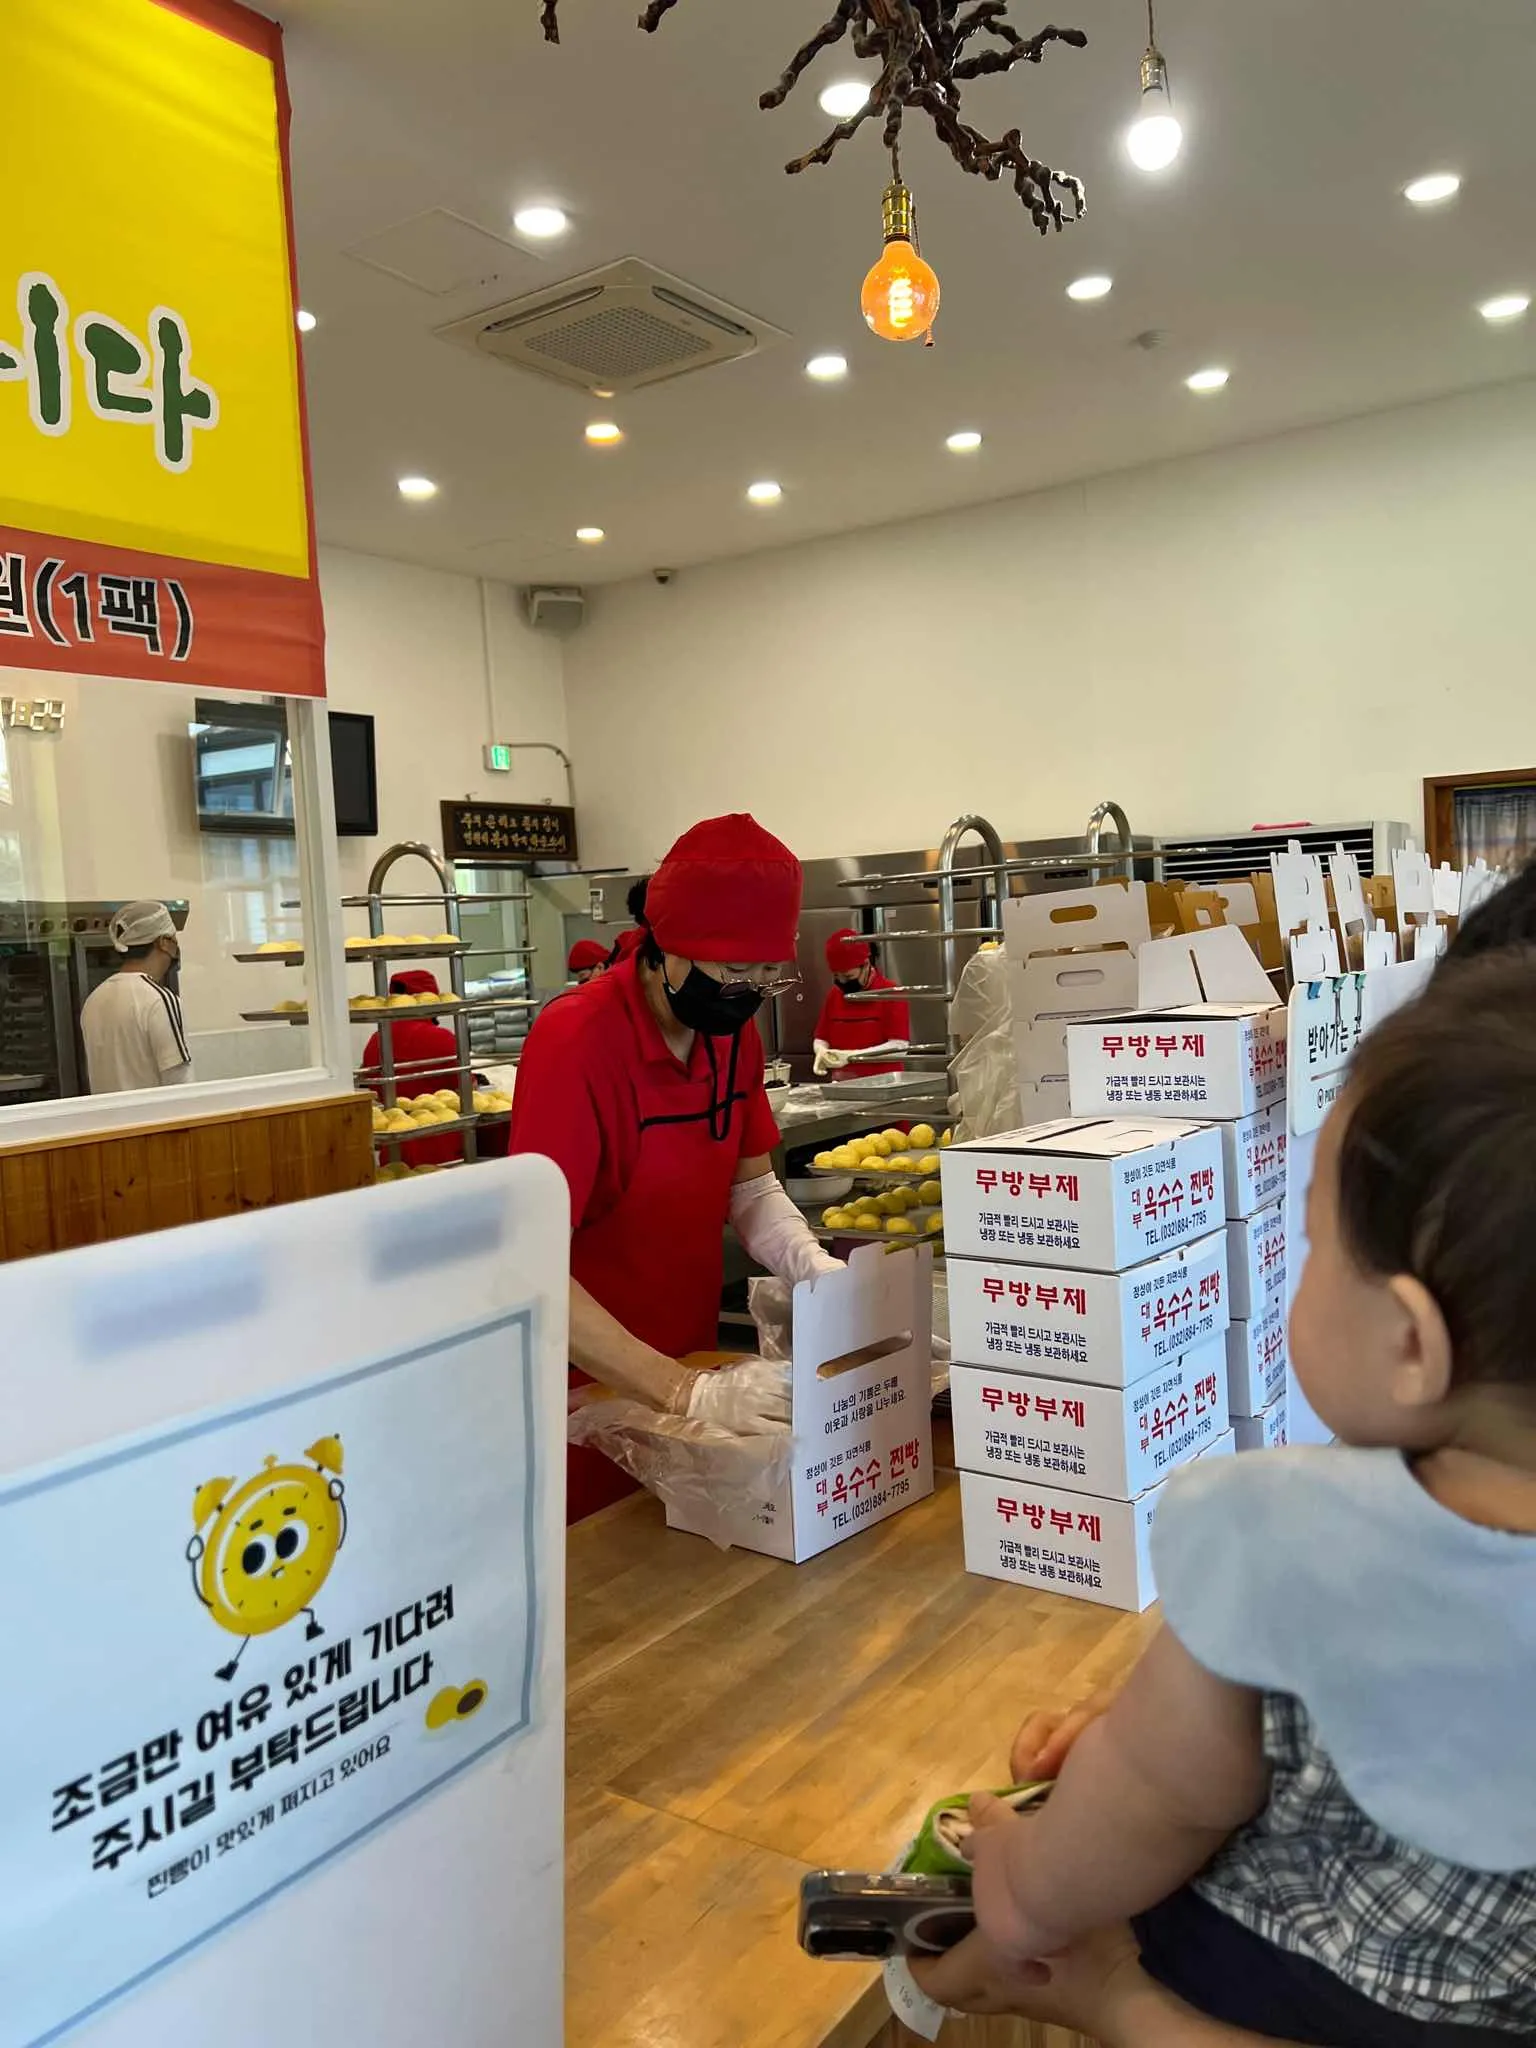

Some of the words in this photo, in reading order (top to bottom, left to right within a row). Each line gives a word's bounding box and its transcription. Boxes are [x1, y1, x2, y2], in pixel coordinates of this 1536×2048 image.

[1102, 1034, 1204, 1058] 무방부제
[1308, 1020, 1348, 1063] 받아가는
[1106, 1075, 1128, 1087] 가급적
[1131, 1075, 1146, 1087] 빨리
[1148, 1075, 1172, 1087] 드시고
[1174, 1075, 1206, 1087] 보관시는
[1107, 1090, 1123, 1101] 냉장
[1126, 1090, 1142, 1101] 또는
[1145, 1090, 1161, 1101] 냉동
[1164, 1090, 1207, 1101] 보관하세요
[976, 1169, 1079, 1202] 무방부제
[1124, 1168, 1141, 1184] 정성이
[1142, 1164, 1153, 1177] 깃든
[1155, 1157, 1176, 1174] 자연식품
[1144, 1179, 1184, 1221] 옥수수
[1190, 1166, 1213, 1206] 찐빵
[979, 1212, 1001, 1226] 가급적
[1003, 1214, 1018, 1228] 빨리
[1021, 1216, 1044, 1229] 드시고
[1047, 1218, 1079, 1233] 보관시는
[980, 1228, 996, 1241] 냉장
[998, 1230, 1015, 1243] 또는
[1018, 1232, 1034, 1245] 냉동
[1037, 1234, 1080, 1249] 보관하세요
[983, 1277, 1086, 1315] 무방부제
[1153, 1286, 1192, 1332] 옥수수
[1200, 1269, 1220, 1311] 찐빵
[986, 1321, 1008, 1336] 가급적
[1010, 1325, 1025, 1339] 빨리
[1028, 1327, 1051, 1341] 드시고
[1054, 1331, 1086, 1347] 보관시는
[987, 1337, 1002, 1351] 냉장
[1006, 1340, 1022, 1353] 또는
[1025, 1342, 1041, 1357] 냉동
[1044, 1346, 1088, 1363] 보관하세요
[824, 1414, 848, 1434] 이웃과
[851, 1403, 873, 1423] 사랑을
[876, 1389, 904, 1411] 나누세요
[833, 1393, 856, 1413] 나눔의
[859, 1383, 880, 1402] 기쁨은
[884, 1376, 898, 1390] 두배
[982, 1387, 1084, 1428] 무방부제
[1151, 1393, 1188, 1440] 옥수수
[1194, 1372, 1216, 1415] 찐빵
[806, 1461, 828, 1480] 정성이
[829, 1453, 843, 1469] 깃든
[845, 1440, 871, 1461] 자연식품
[985, 1430, 1007, 1446] 가급적
[1010, 1434, 1025, 1448] 빨리
[1027, 1437, 1051, 1452] 드시고
[1053, 1442, 1085, 1459] 보관시는
[986, 1445, 1002, 1460] 냉장
[1005, 1449, 1021, 1463] 또는
[1024, 1452, 1040, 1467] 냉동
[1043, 1456, 1087, 1475] 보관하세요
[832, 1458, 881, 1503] 옥수수
[890, 1438, 919, 1479] 찐빵
[997, 1497, 1101, 1542] 무방부제
[1000, 1540, 1021, 1556] 가급적
[1024, 1544, 1039, 1560] 빨리
[1042, 1549, 1066, 1564] 드시고
[1068, 1555, 1101, 1573] 보관시는
[1000, 1554, 1016, 1569] 냉장
[1020, 1559, 1036, 1574] 또는
[1039, 1563, 1055, 1578] 냉동
[1058, 1568, 1102, 1588] 보관하세요
[52, 1728, 183, 1832] 조금만
[196, 1683, 272, 1752] 여유
[283, 1637, 352, 1708] 있게
[363, 1583, 454, 1660] 기다려
[92, 1770, 215, 1871] 주시길
[230, 1651, 433, 1792] 부탁드립니다
[147, 1844, 210, 1899] 찐빵이
[216, 1804, 275, 1857] 맛있게
[340, 1735, 391, 1781] 있어요
